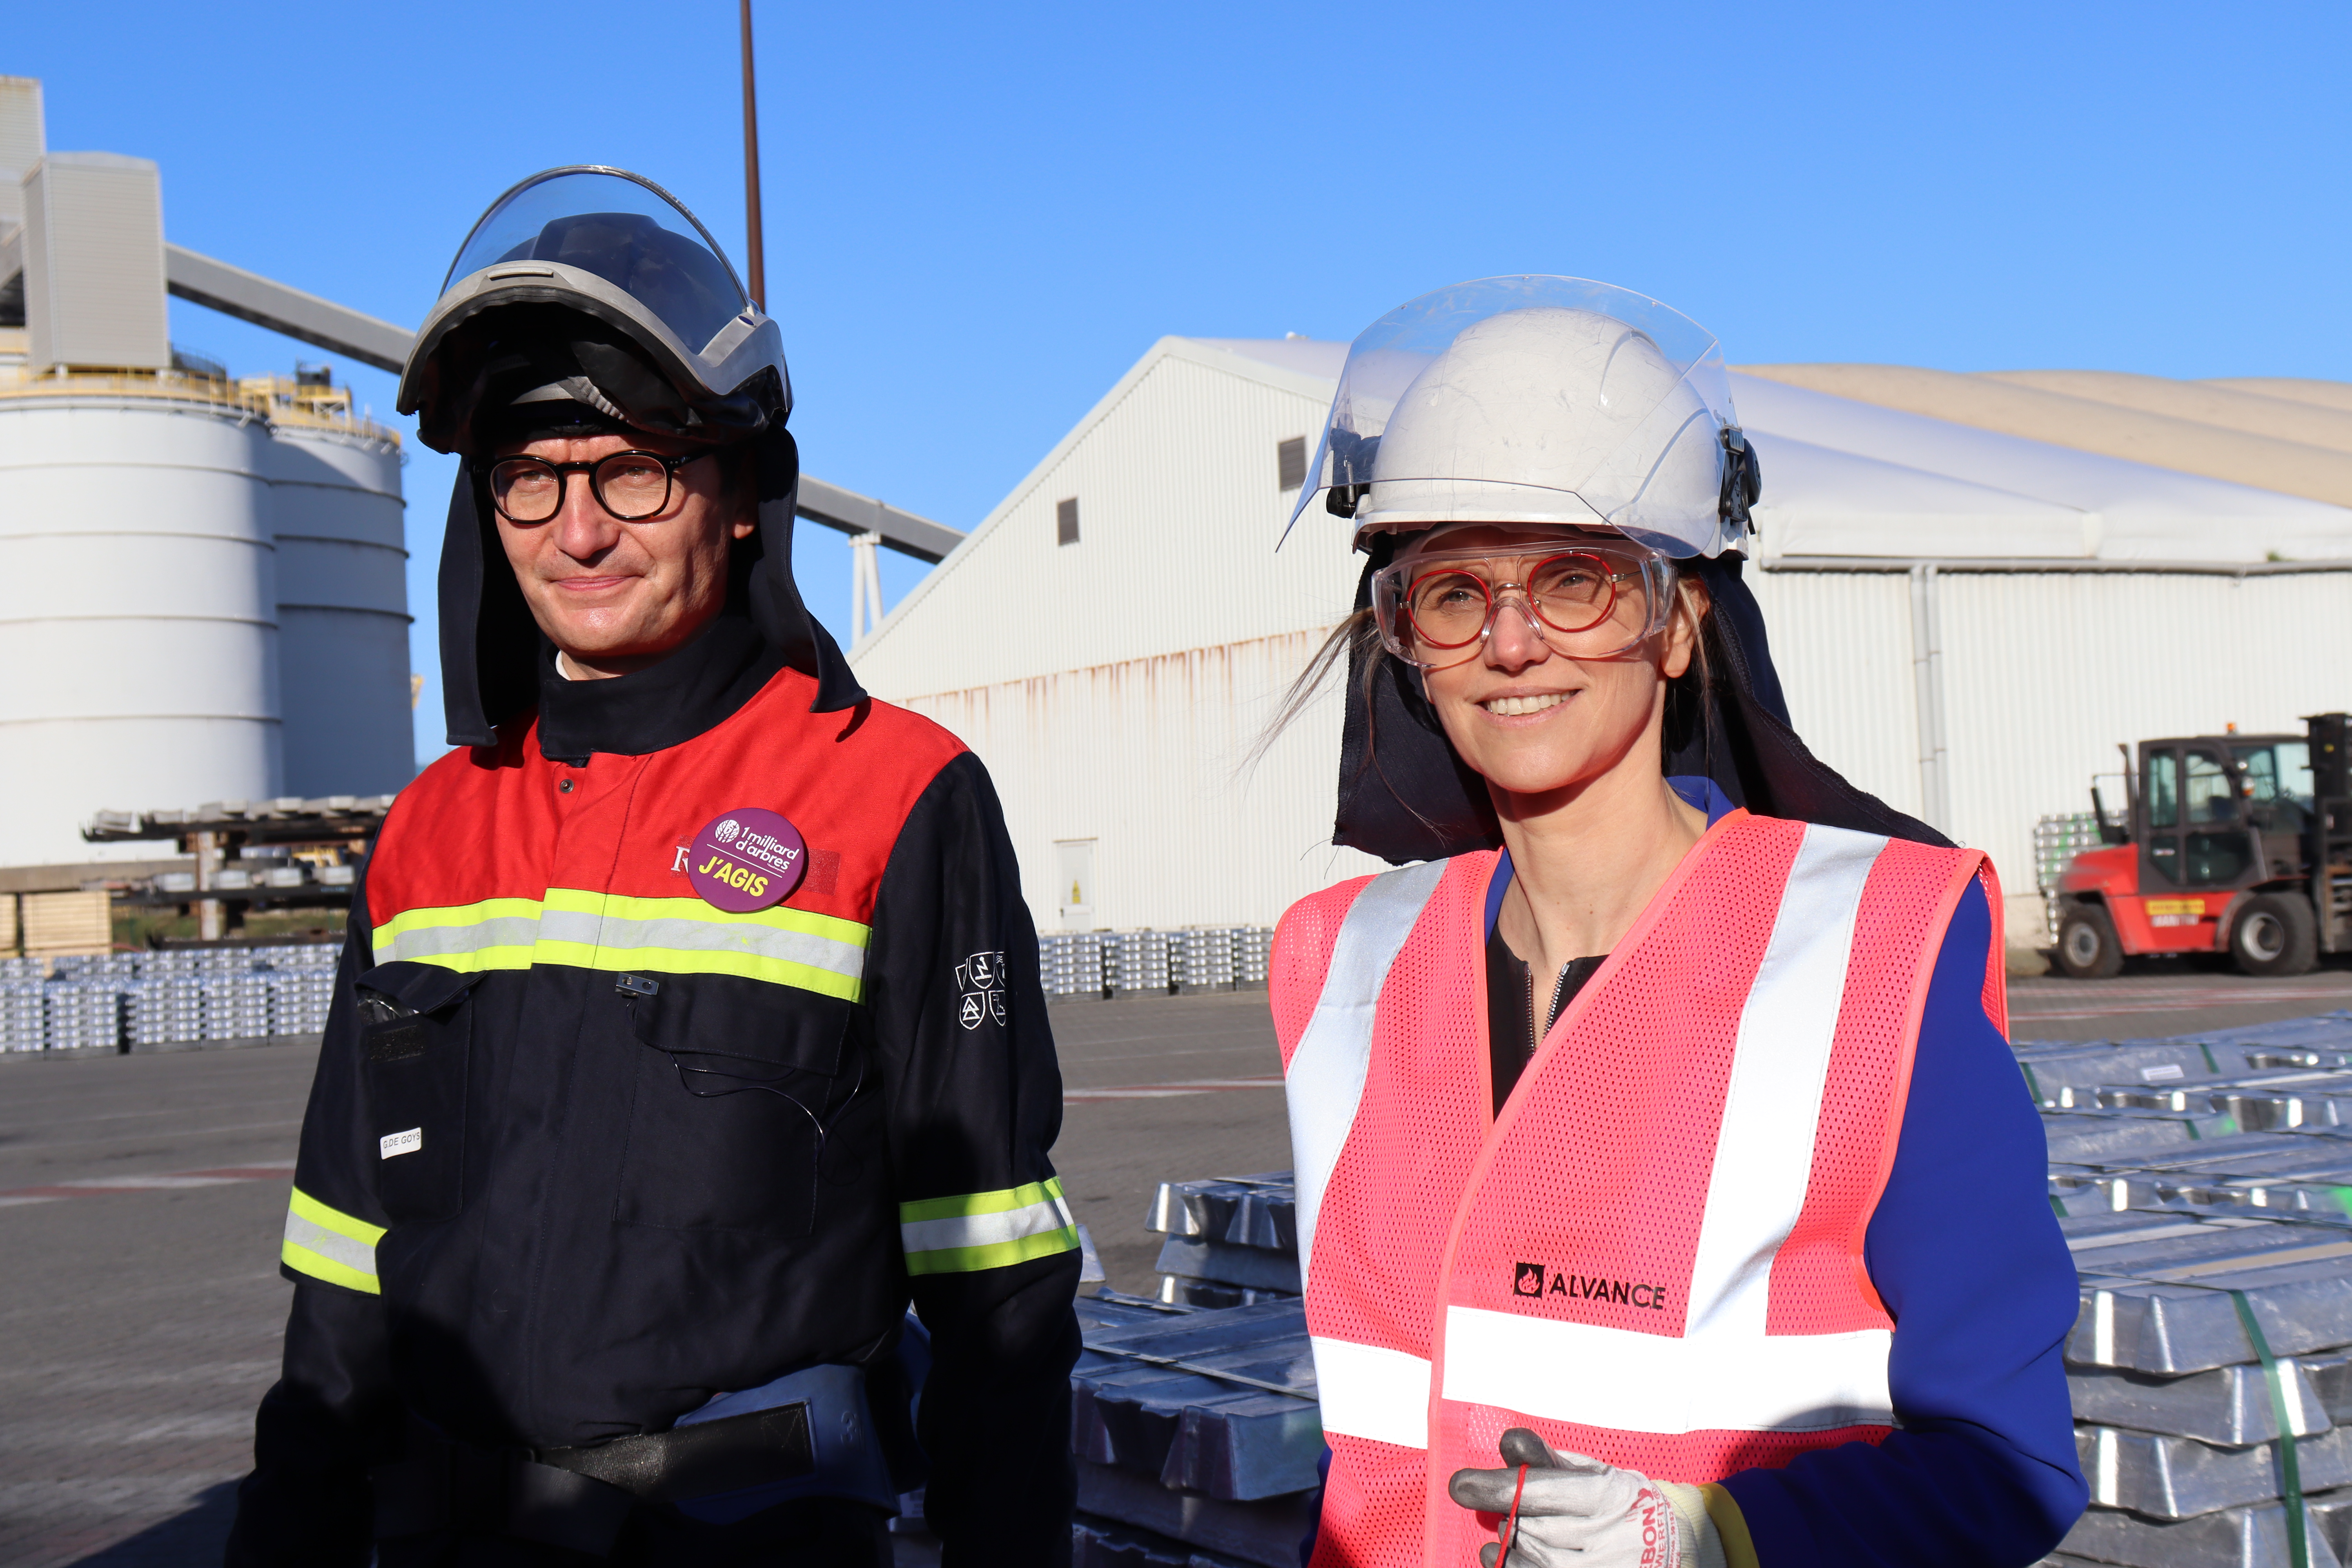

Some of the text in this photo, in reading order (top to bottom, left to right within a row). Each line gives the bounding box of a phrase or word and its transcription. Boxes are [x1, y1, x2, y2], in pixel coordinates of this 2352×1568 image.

[735, 840, 790, 870] d'arbres
[741, 826, 800, 860] 1 milliard
[699, 856, 769, 897] J'AGIS
[401, 1132, 420, 1144] GOYS
[1549, 1273, 1666, 1310] ALVANCE
